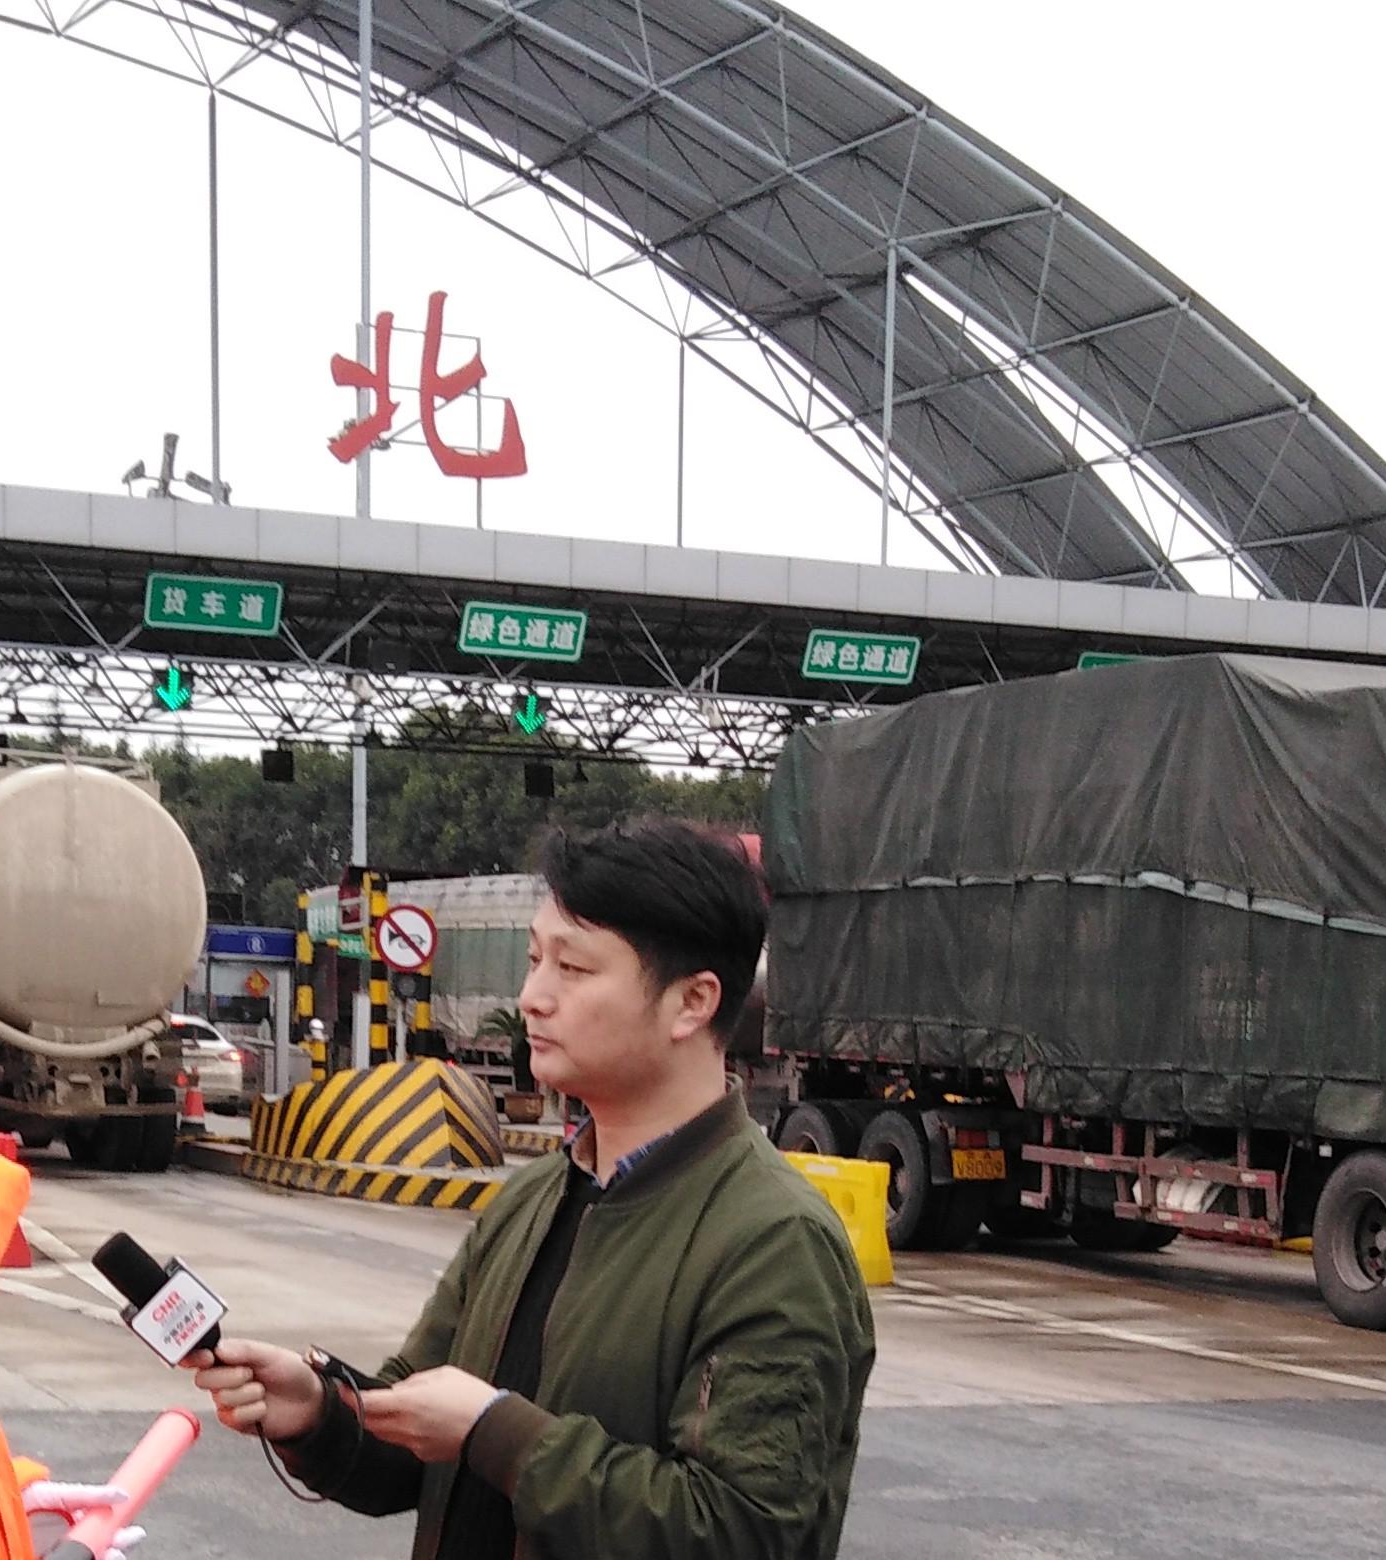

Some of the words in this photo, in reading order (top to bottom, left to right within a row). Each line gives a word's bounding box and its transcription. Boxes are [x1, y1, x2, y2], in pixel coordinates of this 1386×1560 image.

[161, 585, 265, 623] 货车道
[468, 611, 578, 651] 绿色通道
[810, 639, 911, 675] 绿色通道
